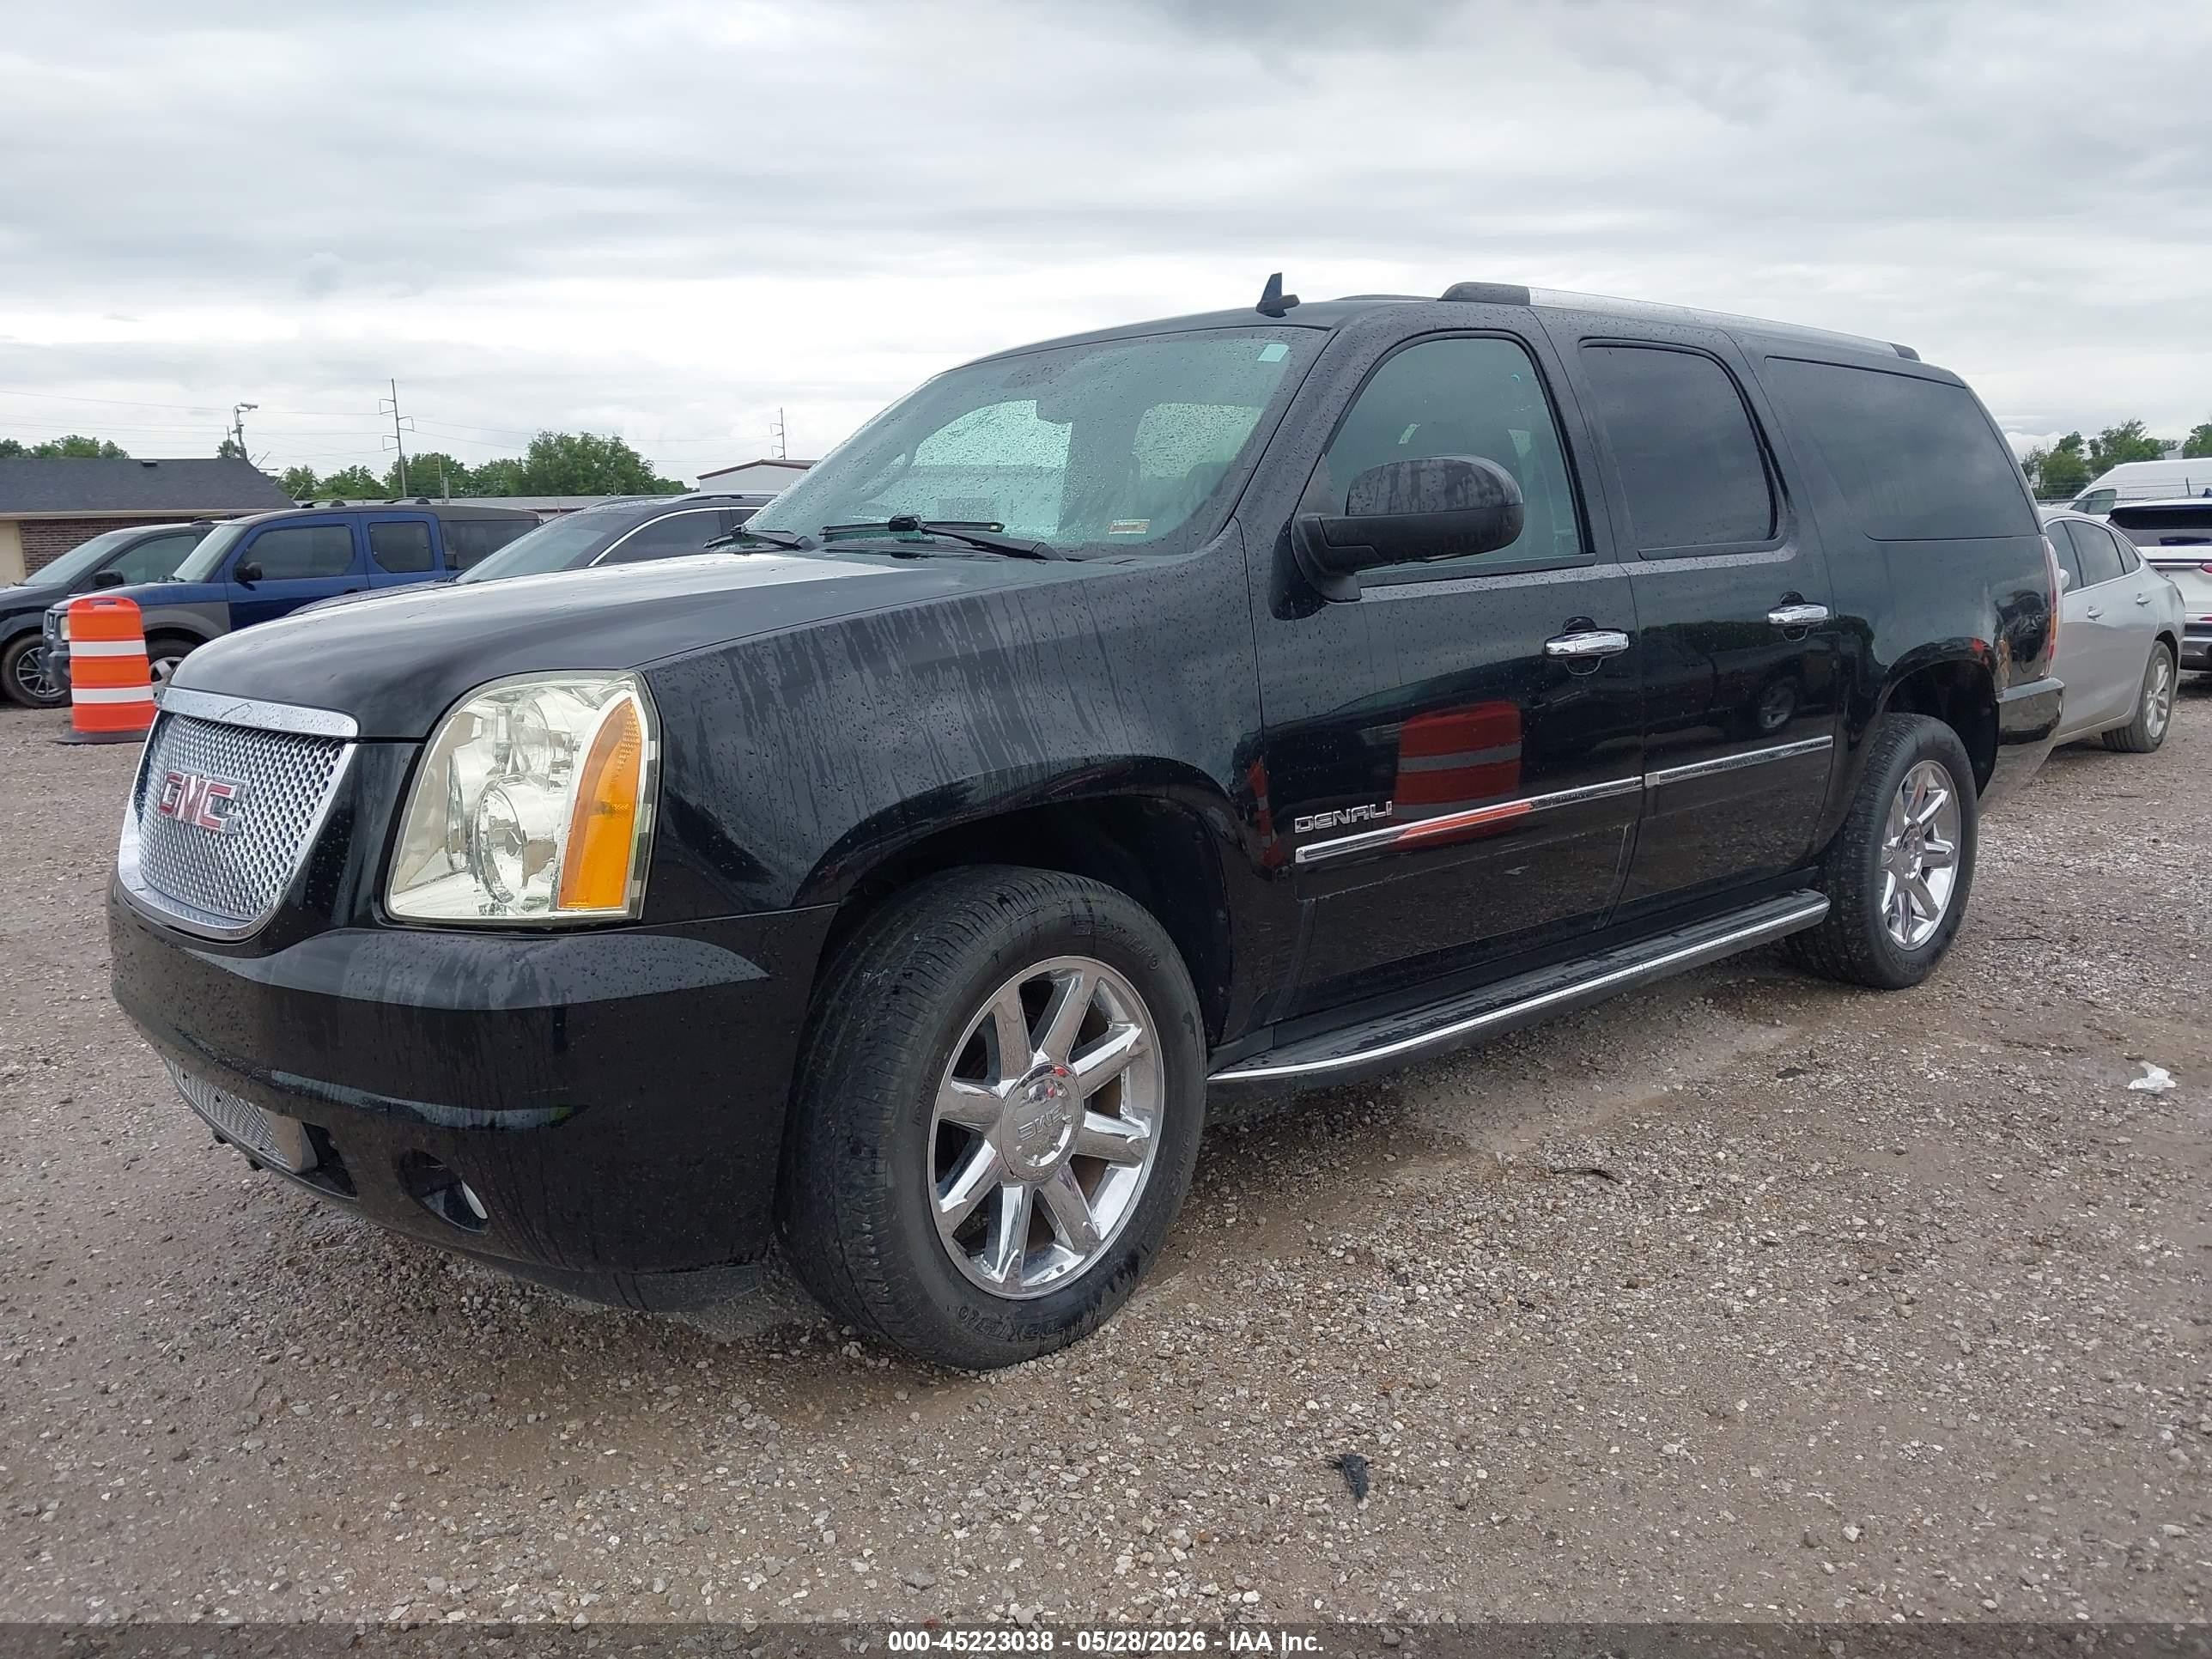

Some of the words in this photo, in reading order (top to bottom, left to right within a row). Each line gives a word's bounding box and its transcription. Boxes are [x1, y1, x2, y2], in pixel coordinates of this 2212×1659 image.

[158, 770, 243, 834] GMC
[1294, 800, 1393, 834] DENALI
[1017, 1104, 1065, 1142] GMC
